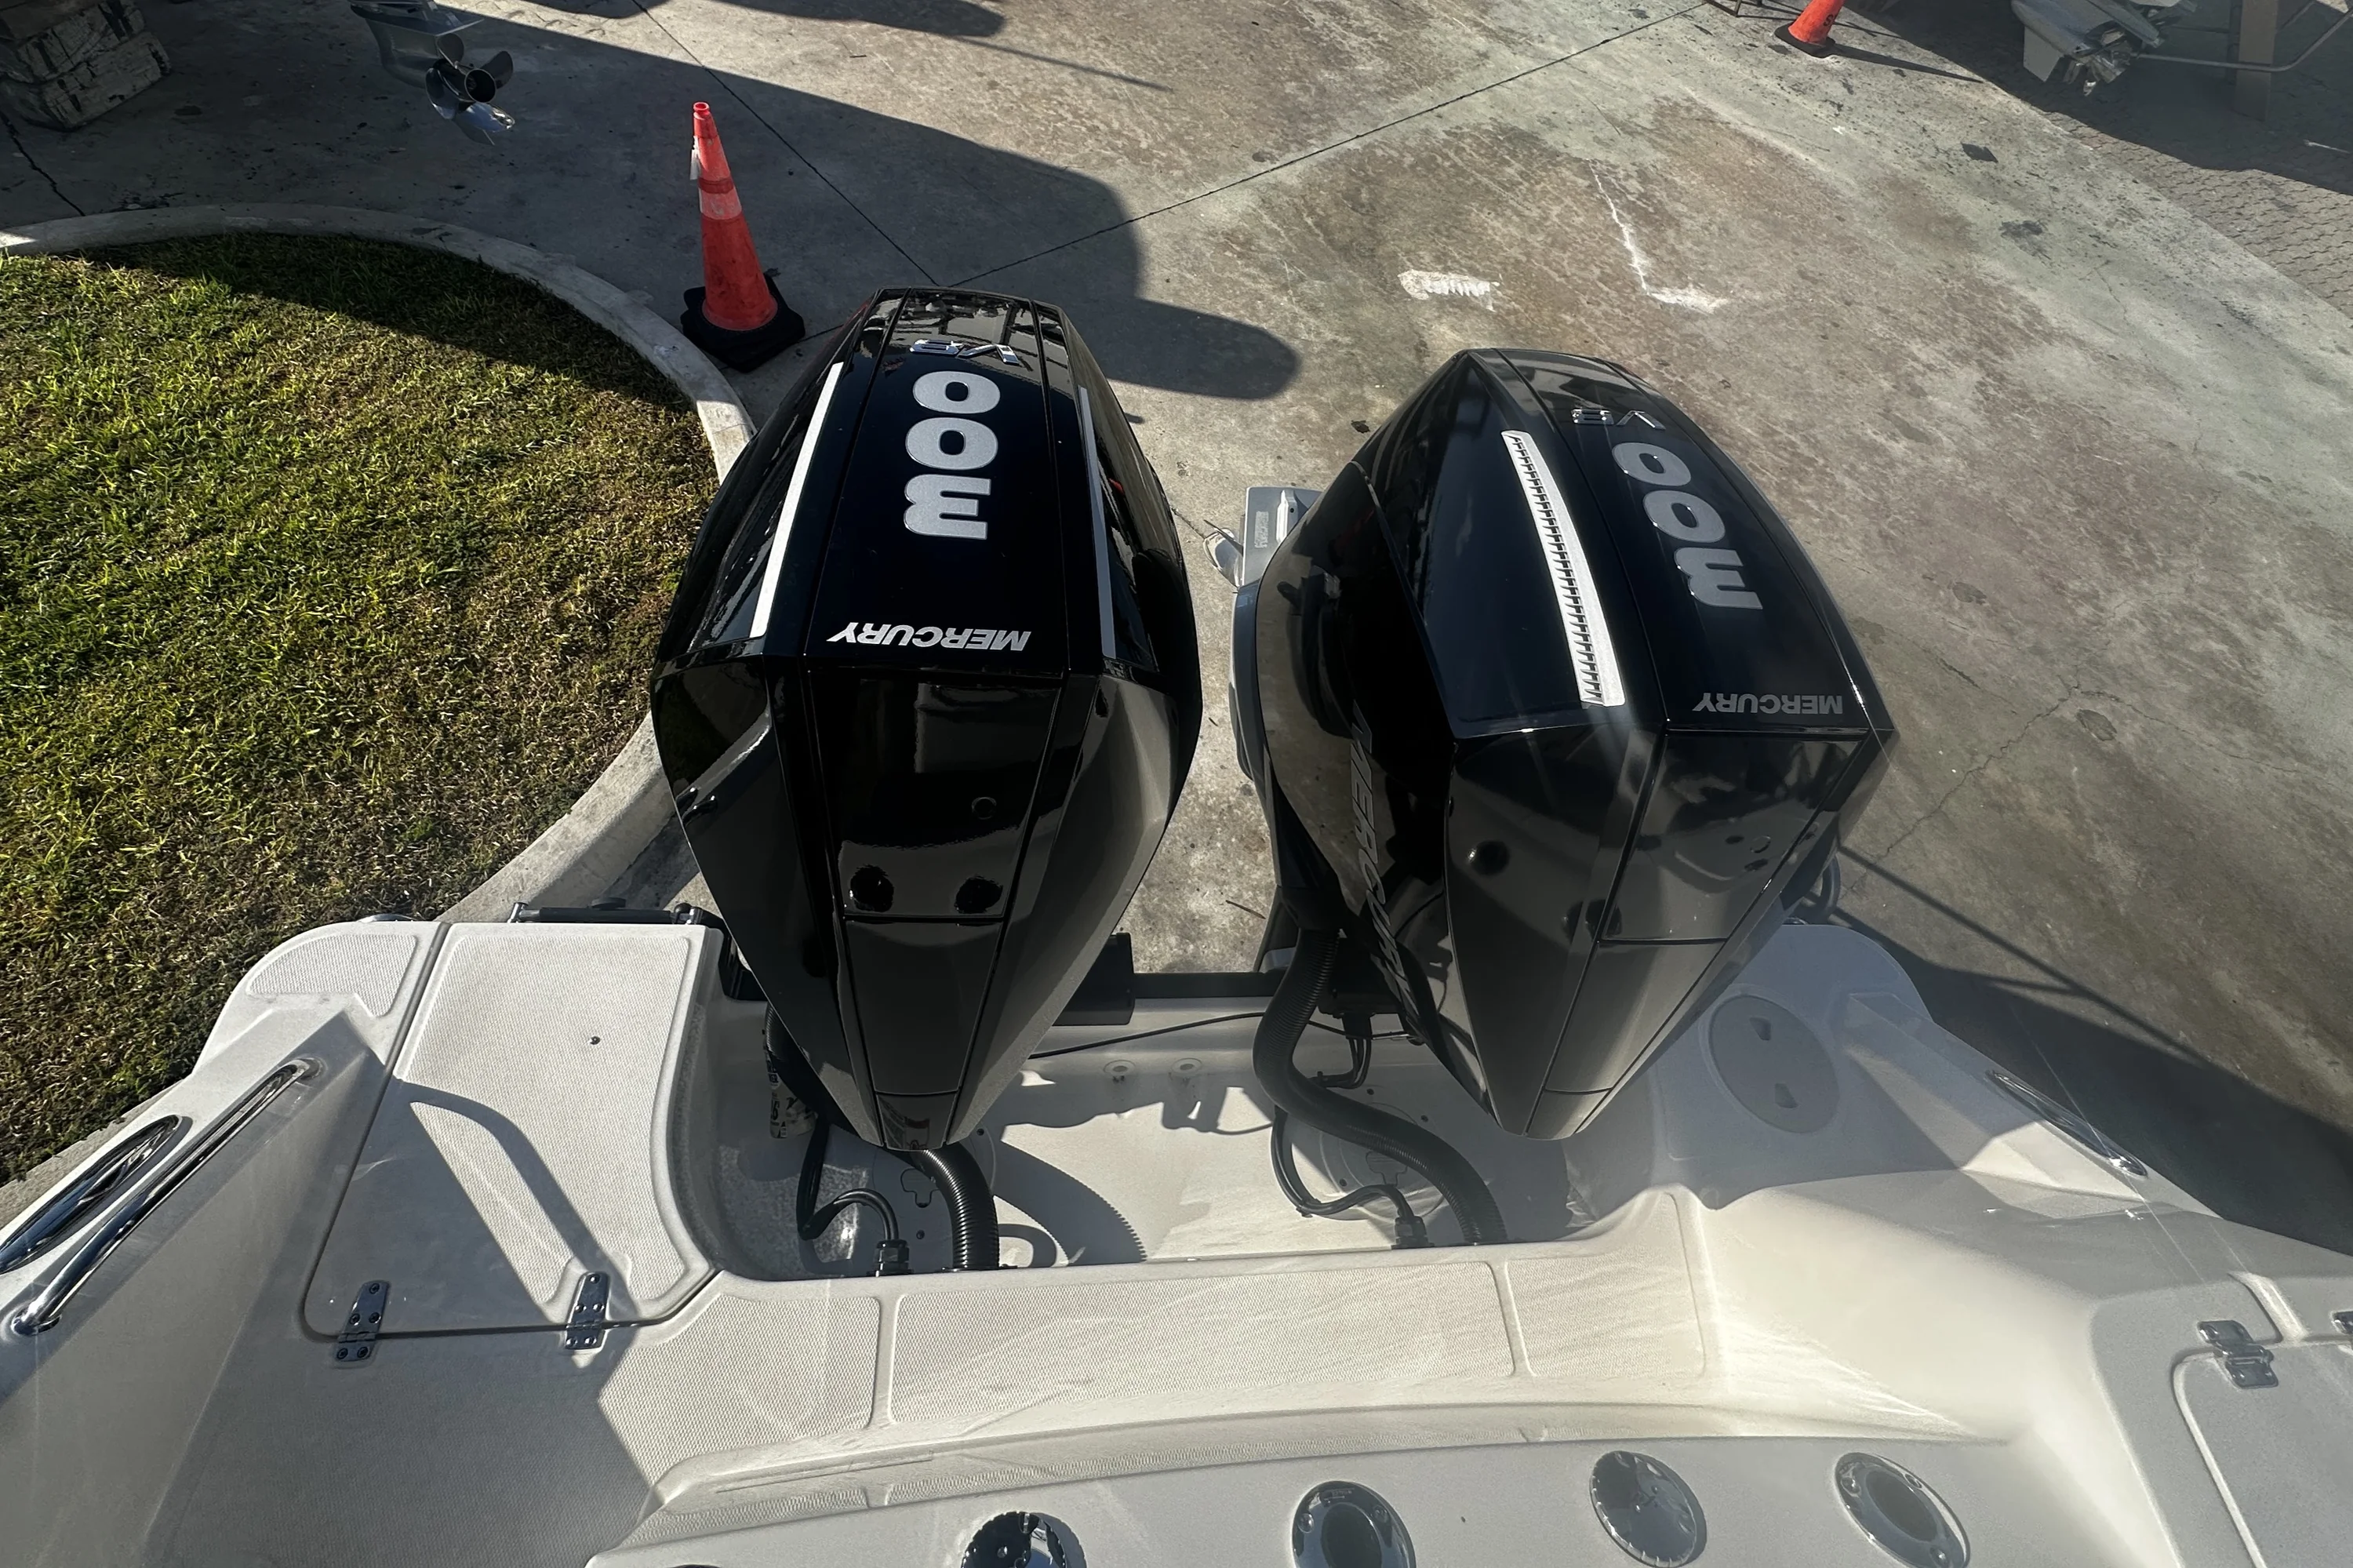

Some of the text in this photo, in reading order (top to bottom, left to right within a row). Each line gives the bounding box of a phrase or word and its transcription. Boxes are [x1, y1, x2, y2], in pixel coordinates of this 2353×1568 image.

[903, 370, 1001, 540] 300
[1612, 442, 1764, 611] 300
[826, 622, 1031, 652] MERCURY
[1692, 693, 1843, 715] MERCURY
[1350, 699, 1420, 1018] MERCURY
